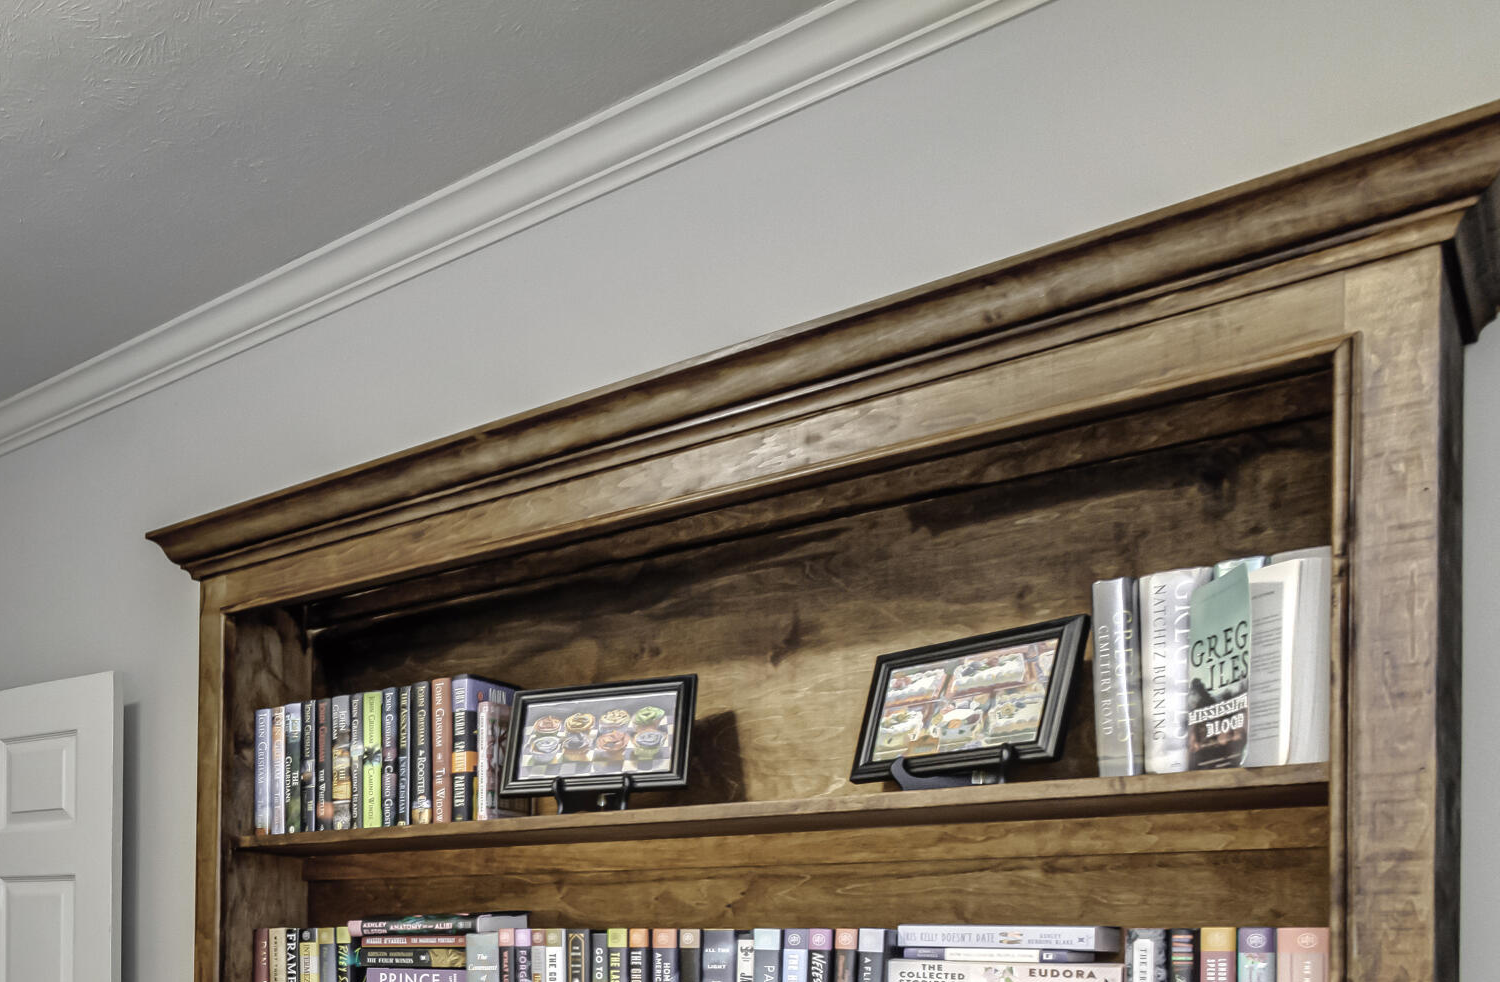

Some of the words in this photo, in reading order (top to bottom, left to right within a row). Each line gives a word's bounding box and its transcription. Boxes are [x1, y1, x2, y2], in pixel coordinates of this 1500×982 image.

[1191, 621, 1247, 667] GREG
[1206, 651, 1249, 691] ILES
[435, 683, 444, 704] JOHN
[1153, 665, 1167, 740] BURNING
[435, 709, 444, 748] GRISHAM
[434, 768, 445, 785] THE
[548, 954, 556, 969] THE
[596, 948, 603, 963] GO
[610, 953, 620, 967] THE
[632, 951, 642, 964] THE
[596, 966, 603, 980] TO
[922, 964, 943, 972] THE
[1029, 969, 1097, 979] EUDORA
[899, 972, 965, 980] COLLECTED
